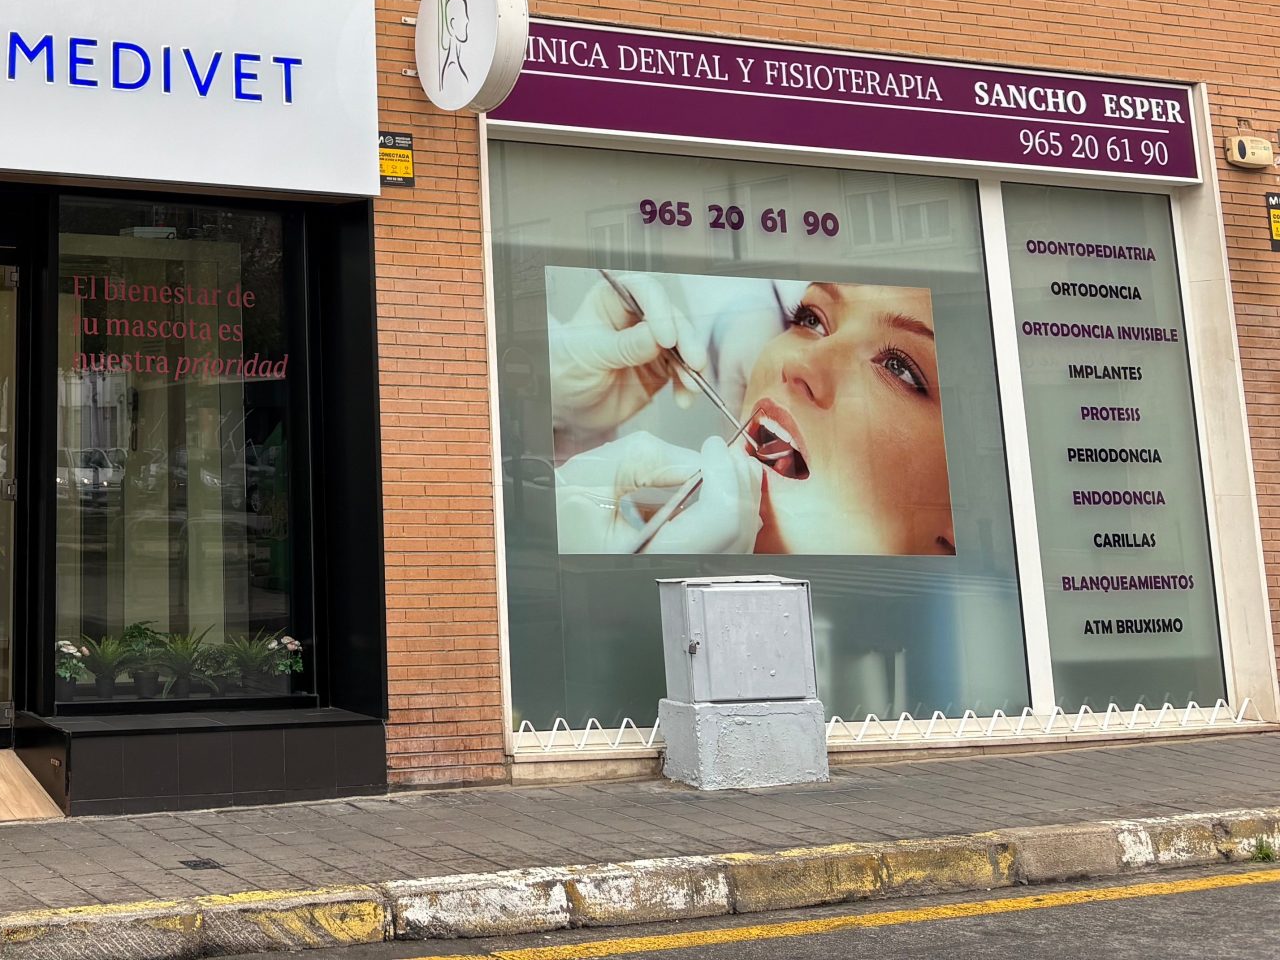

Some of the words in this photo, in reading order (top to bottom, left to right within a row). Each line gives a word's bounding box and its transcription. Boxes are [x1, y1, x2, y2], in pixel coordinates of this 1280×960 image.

[7, 30, 303, 105] MEDIVET
[524, 35, 609, 69] INICA
[618, 45, 728, 81] DENTAL
[736, 58, 755, 84] Y
[764, 60, 943, 102] FISIOTERAPIA
[974, 81, 1087, 116] SANCHO
[1102, 93, 1185, 124] ESPER
[1019, 129, 1062, 157] 965
[1071, 133, 1099, 160] 20
[1106, 136, 1134, 163] 61
[1141, 139, 1169, 166] 90
[639, 199, 693, 227] 965
[708, 204, 745, 230] 20
[761, 207, 788, 233] 61
[803, 211, 840, 237] 90
[1026, 240, 1156, 262] ODONTOPEDIATRIA
[73, 275, 97, 300] El
[104, 276, 222, 307] bienestar
[227, 283, 256, 308] de
[1050, 281, 1142, 300] ORTODONCIA
[106, 317, 213, 341] mascota
[218, 324, 243, 342] es
[1021, 321, 1115, 340] ORTODONCIA
[1117, 325, 1178, 342] INVISIBLE
[73, 351, 170, 375] nuestra
[174, 352, 289, 381] prioridad
[1068, 364, 1143, 381] IMPLANTES
[1080, 405, 1141, 422] PROTESIS
[1067, 447, 1162, 464] PERIODONCIA
[1072, 490, 1166, 506] ENDODONCIA
[1093, 532, 1156, 549] CARILLAS
[1061, 574, 1195, 592] BLANQUEAMIENTOS
[1084, 619, 1113, 635] ATM
[1116, 618, 1184, 634] BRUXISMO
